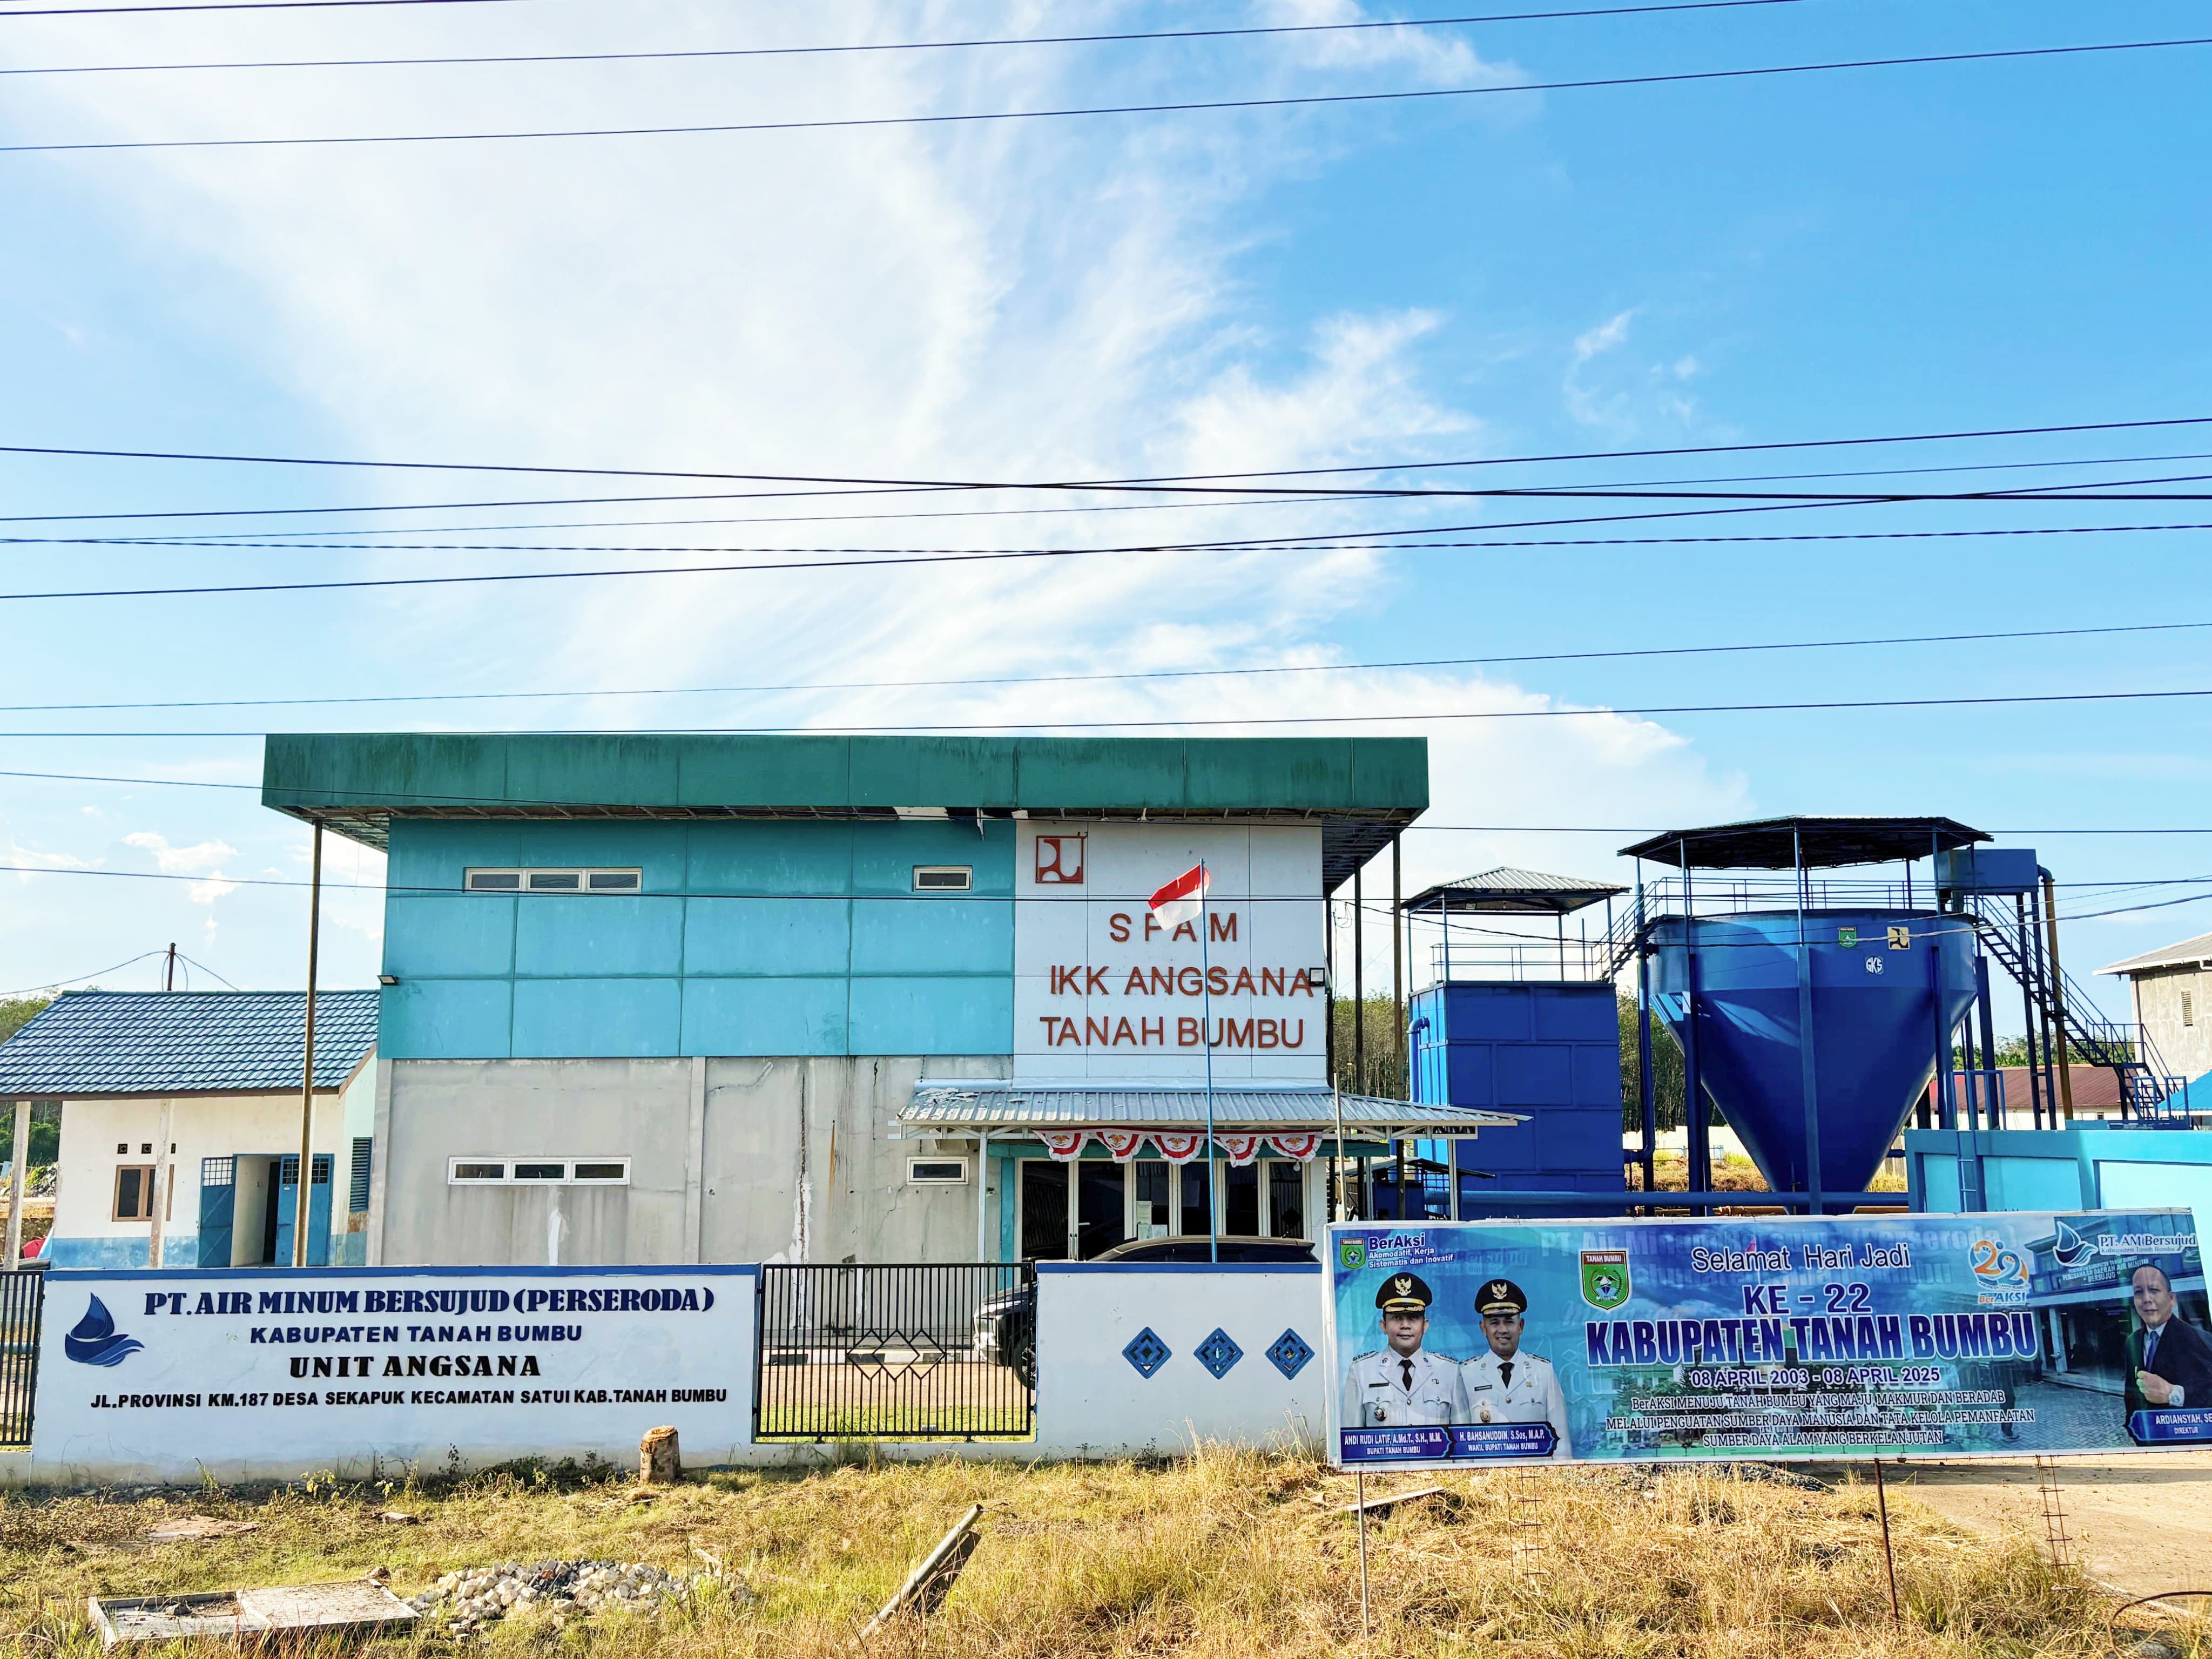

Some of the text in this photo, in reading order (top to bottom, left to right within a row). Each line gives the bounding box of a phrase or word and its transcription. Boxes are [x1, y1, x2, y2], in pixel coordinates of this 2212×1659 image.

[1050, 965, 1314, 997] IKK ANGSANA
[1040, 1016, 1304, 1048] TANAH BUMBU
[1369, 1233, 1425, 1250] BerAksi
[1368, 1247, 1434, 1259] Akomodatif, Kerja
[1368, 1259, 1408, 1269] Sistematis
[1426, 1254, 1454, 1263] Inovatif
[1692, 1244, 1910, 1271] Selamat Hari Jadi
[257, 1291, 360, 1314] MINUM
[1743, 1285, 1790, 1315] KE
[1825, 1284, 1872, 1314] 22
[250, 1325, 582, 1344] KABUPATEN TANAH BUMBU
[1586, 1312, 2038, 1366] KABUPATEN TANAH BUMBU
[289, 1355, 541, 1378] UNIT ANGSANA
[1692, 1370, 1711, 1387] 08
[1716, 1370, 1766, 1386] APRIL
[1771, 1369, 1808, 1384] 2003
[1823, 1370, 1842, 1384] 08
[1847, 1368, 1898, 1384] APRIL
[1902, 1367, 1940, 1382] 2025
[208, 1393, 269, 1407] KM.187
[273, 1392, 319, 1406] DESA
[325, 1391, 405, 1405] SEKAPUK
[411, 1391, 515, 1404] KECAMATAN
[520, 1390, 570, 1404] SATUI
[671, 1389, 727, 1402] BUMBU
[1633, 1391, 2005, 1410] BerAKSI MENUJU TANAH BUMBU YANG MAJU, MAKMUR DAN BERADAB
[1606, 1410, 2034, 1429] MELALUI PENGUATAN SUMBER DAYA MANUSIA DAN TATA KELOLA PEMANFAATAN
[2156, 1414, 2203, 1425] ARDIANSYAH,
[1344, 1435, 1358, 1445] ANDI
[1360, 1435, 1373, 1445] RUDI
[1375, 1434, 1392, 1445] LATIF,
[1460, 1432, 1466, 1441] H.
[1528, 1429, 1545, 1439] M.A.P.
[1703, 1431, 1943, 1447] SUMBER DAYA ALAM YANG BERKELANJUTAN
